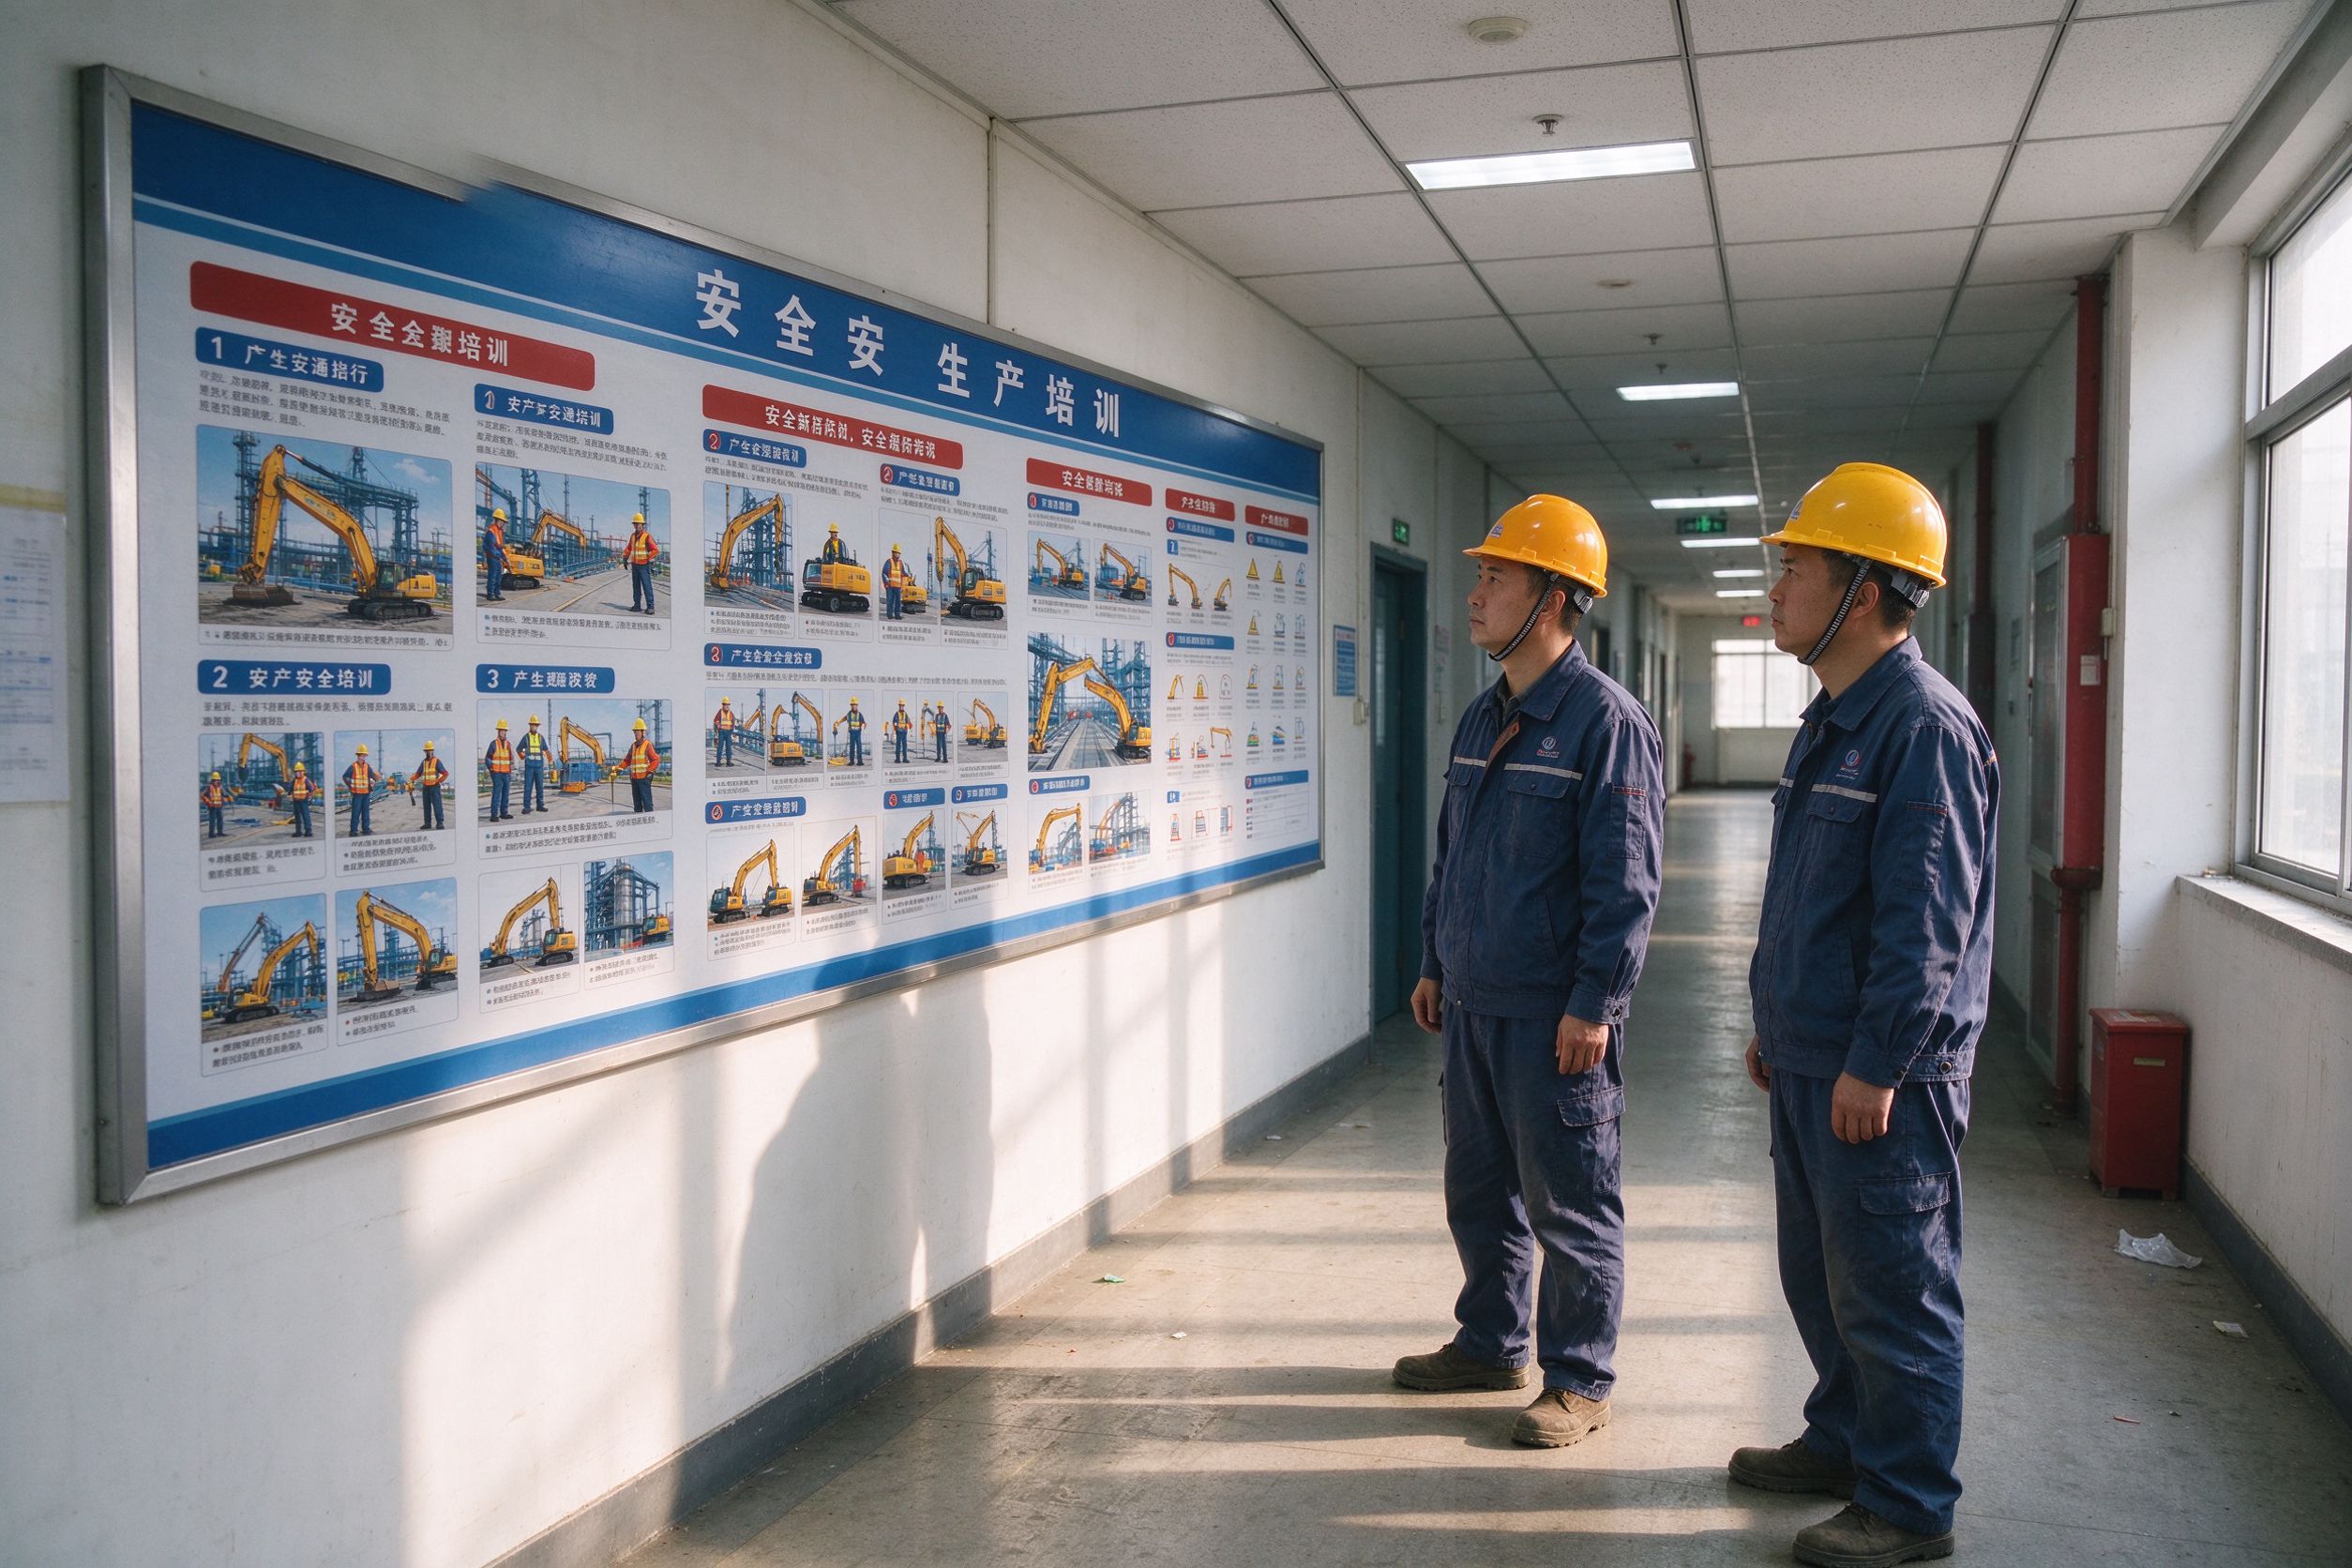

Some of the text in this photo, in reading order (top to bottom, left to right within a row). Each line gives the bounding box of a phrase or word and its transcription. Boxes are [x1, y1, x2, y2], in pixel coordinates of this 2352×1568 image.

[211, 336, 222, 359] 1
[213, 665, 228, 688] 2
[487, 669, 499, 689] 3
